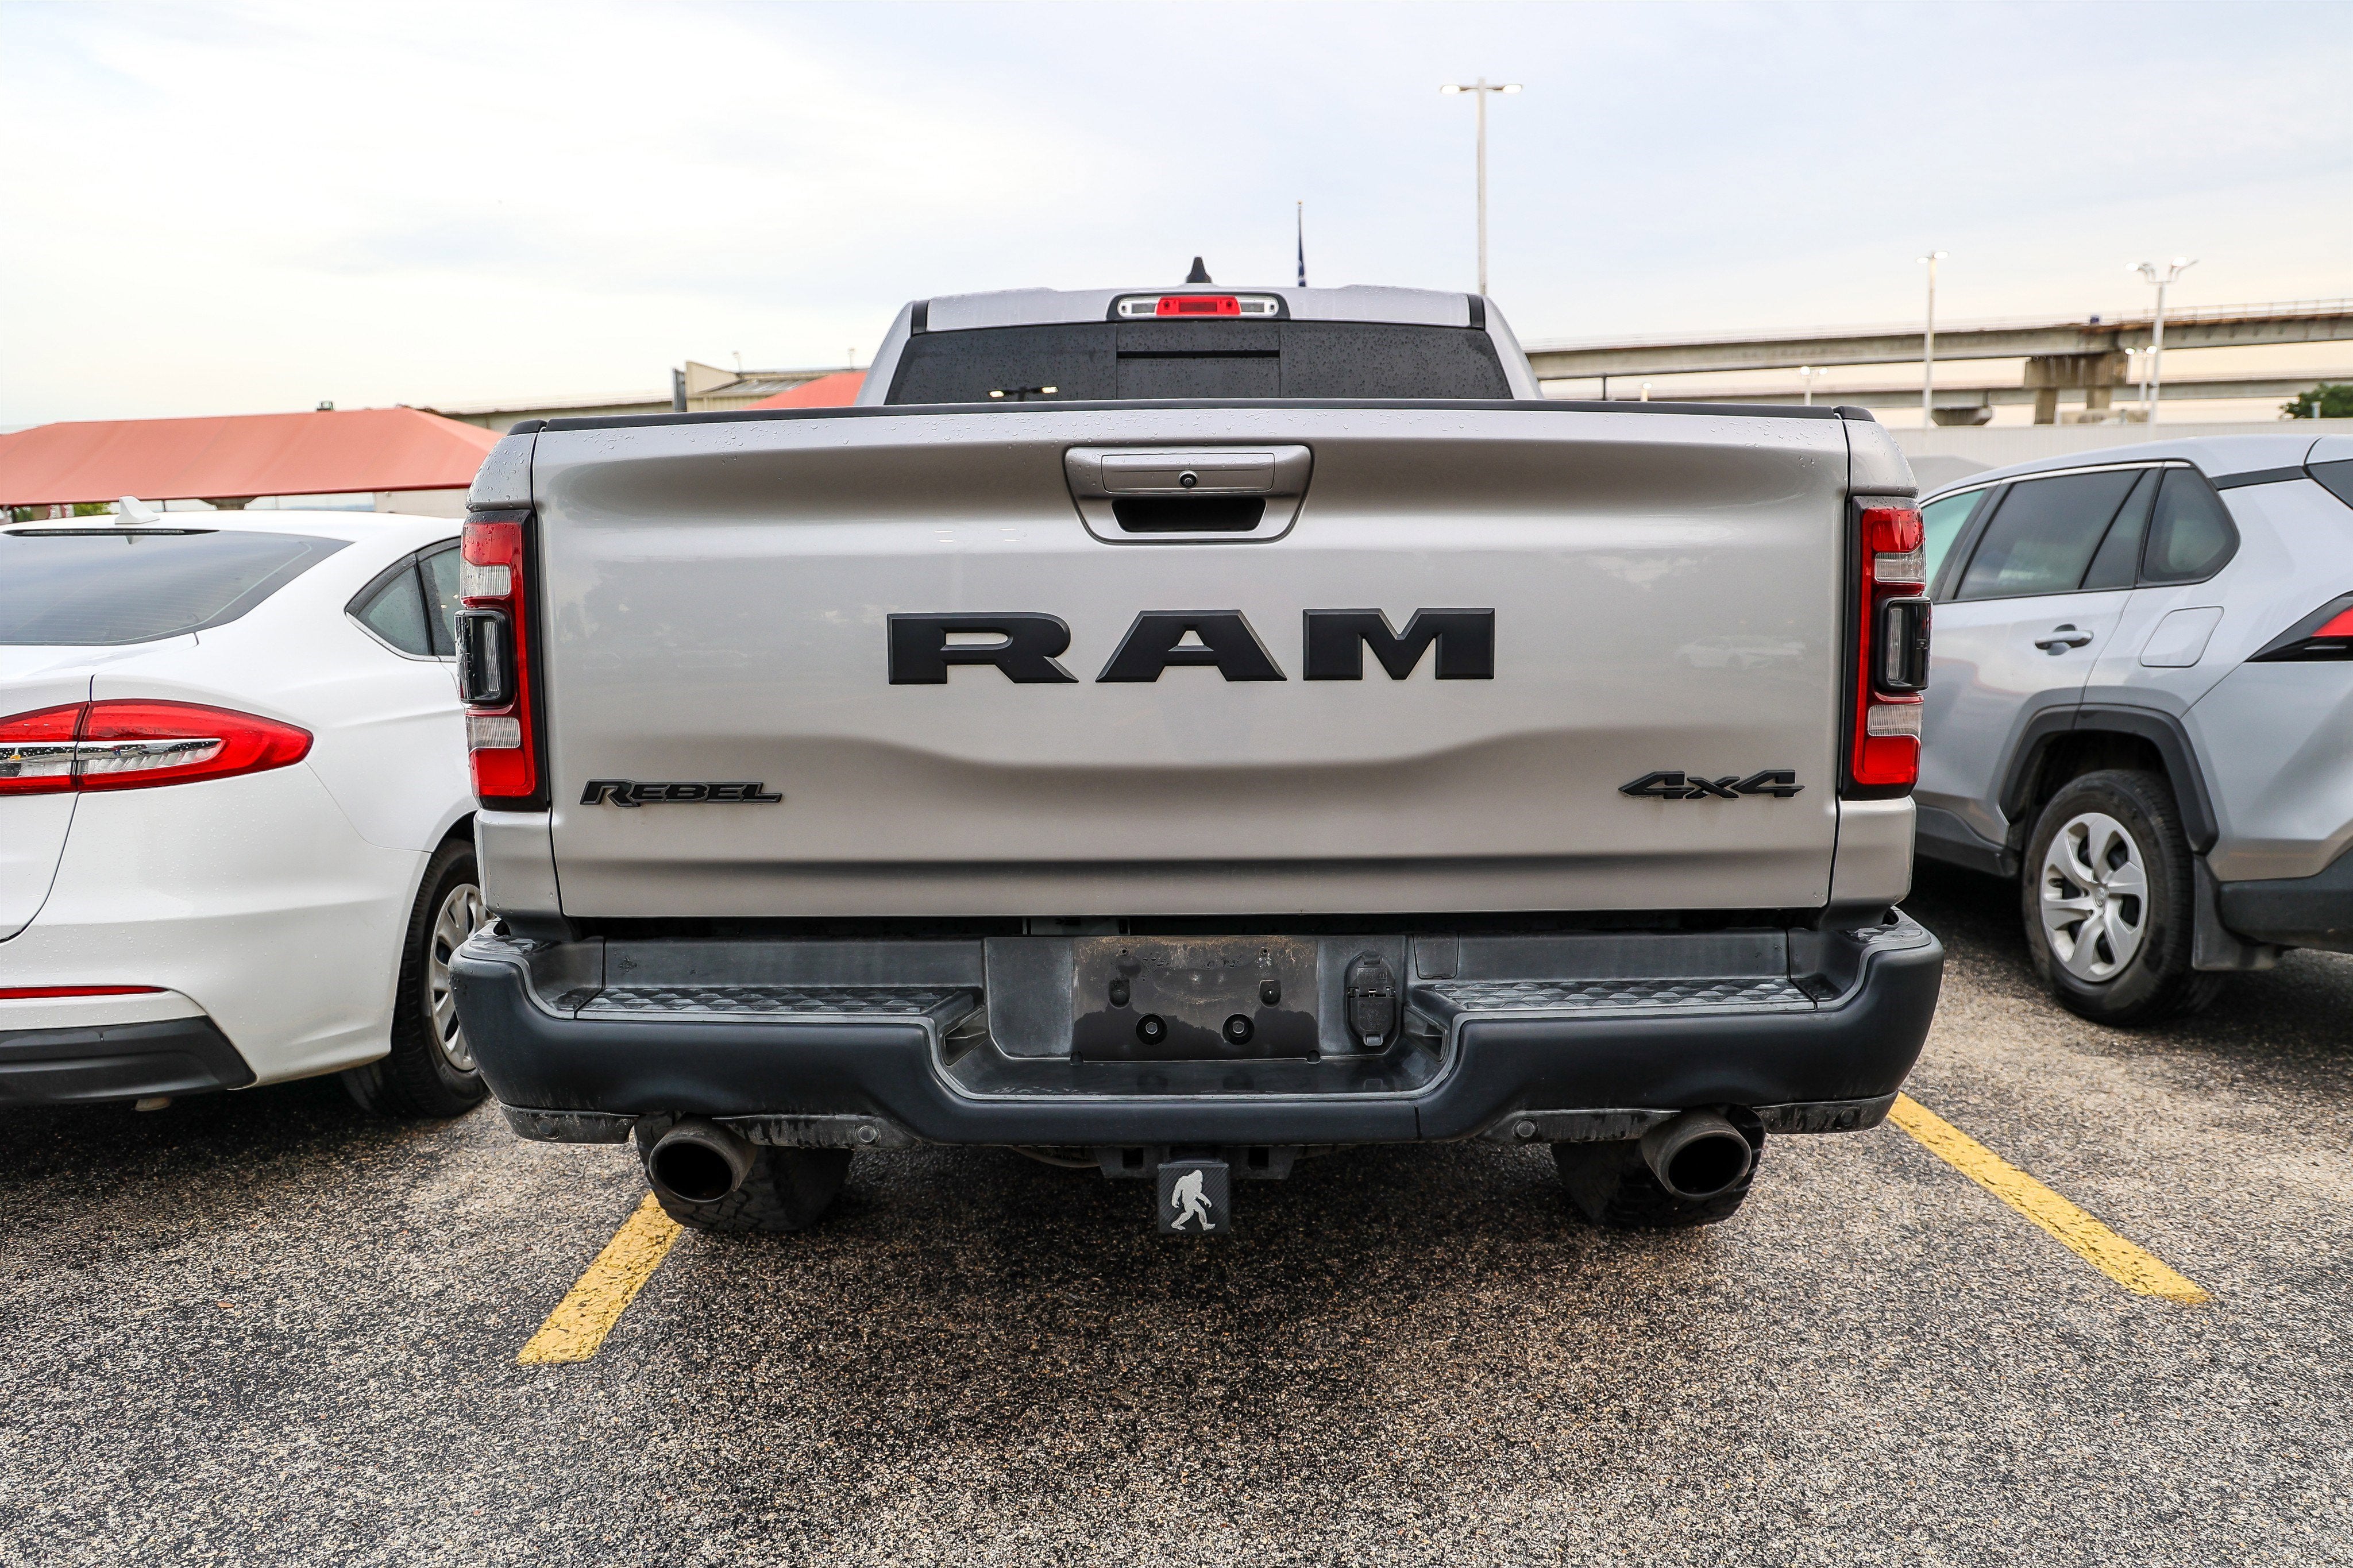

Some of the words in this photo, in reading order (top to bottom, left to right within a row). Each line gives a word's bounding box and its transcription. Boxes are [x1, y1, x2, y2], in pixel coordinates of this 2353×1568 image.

[886, 608, 1495, 684] RAM
[579, 779, 782, 807] REBEL
[1618, 769, 1806, 800] 4x4
